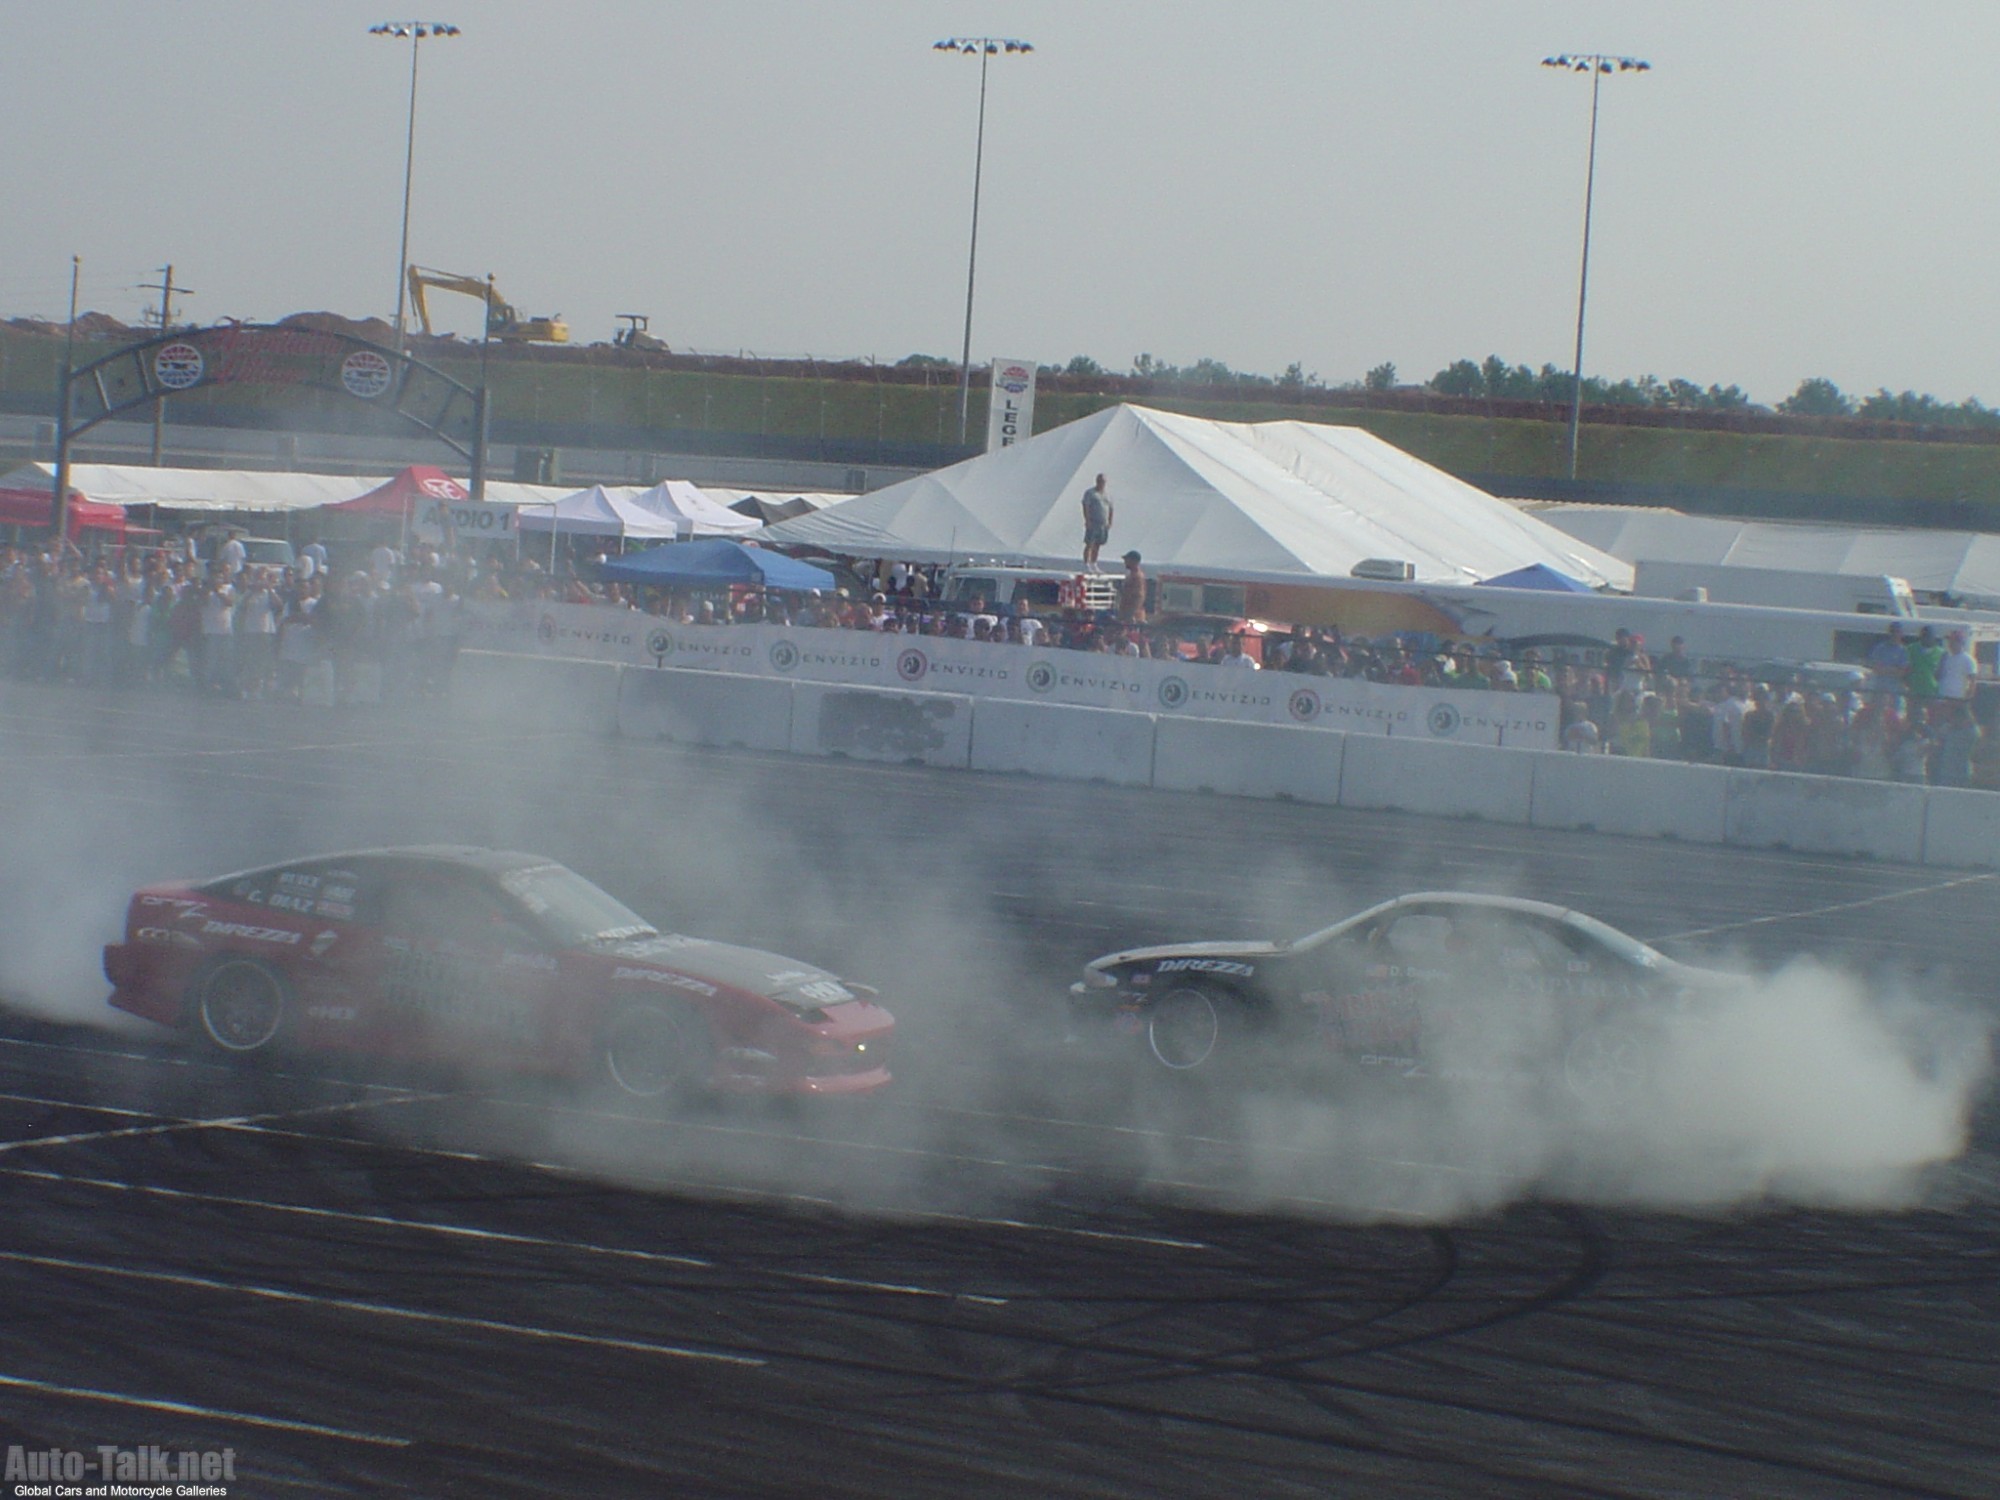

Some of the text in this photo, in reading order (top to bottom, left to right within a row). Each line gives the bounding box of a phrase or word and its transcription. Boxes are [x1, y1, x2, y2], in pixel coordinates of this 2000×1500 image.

[422, 506, 494, 530] ADIO
[558, 629, 1547, 732] ENVIZIO ENVIZIO ENVIZIO ENVIZIO ENVIZIO ENVIZIO ENVIZIO ENVIZIO
[1157, 959, 1255, 978] DIREZZA
